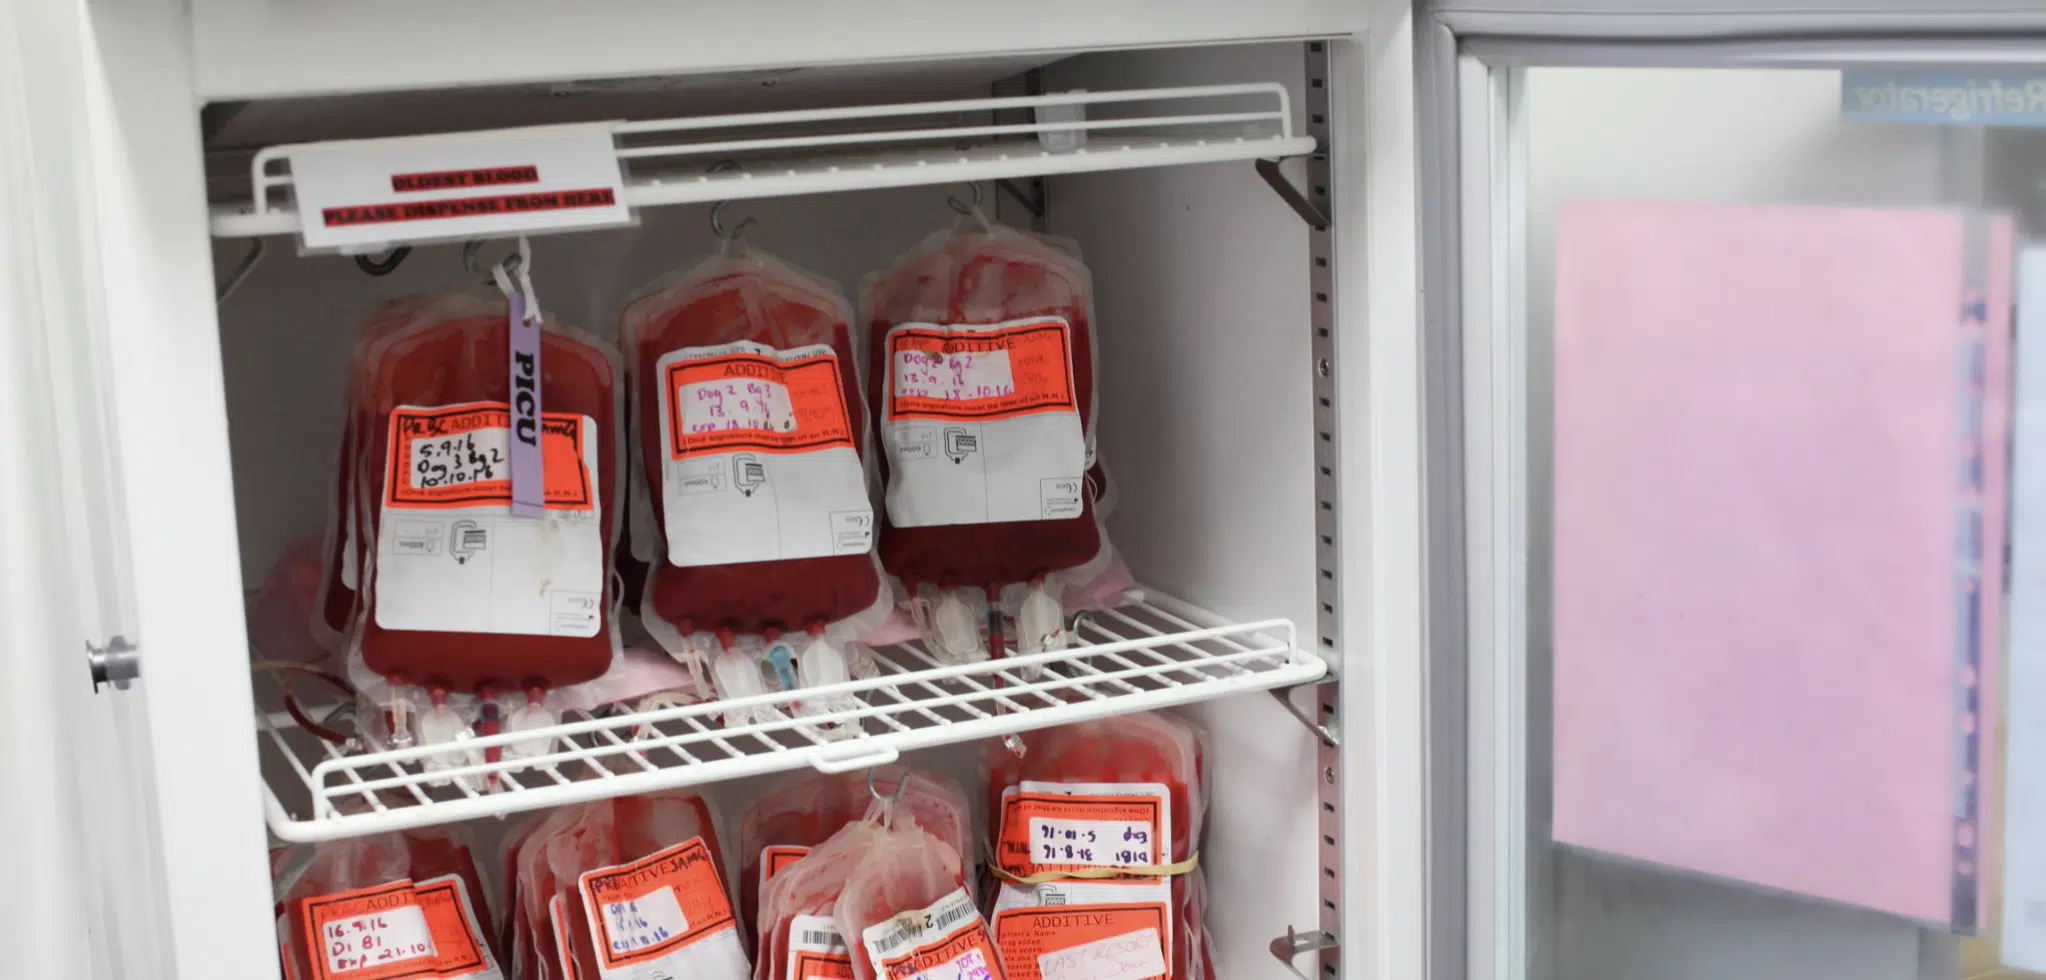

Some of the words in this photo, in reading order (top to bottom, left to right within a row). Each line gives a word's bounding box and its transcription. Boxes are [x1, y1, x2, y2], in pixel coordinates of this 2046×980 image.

[393, 172, 466, 191] OLDEST
[473, 166, 538, 184] BLOOD
[323, 203, 400, 226] PLEASE
[405, 196, 499, 220] DISPENSE
[504, 191, 558, 213] FROM
[514, 350, 537, 447] PICU
[726, 384, 737, 396] 2
[451, 413, 509, 430] ADDIT
[417, 459, 448, 481] Dog
[453, 453, 463, 470] 3
[489, 447, 505, 464] 2
[1122, 826, 1148, 845] Exp
[1032, 912, 1114, 928] ADDITIVE
[1001, 931, 1031, 939] atient's
